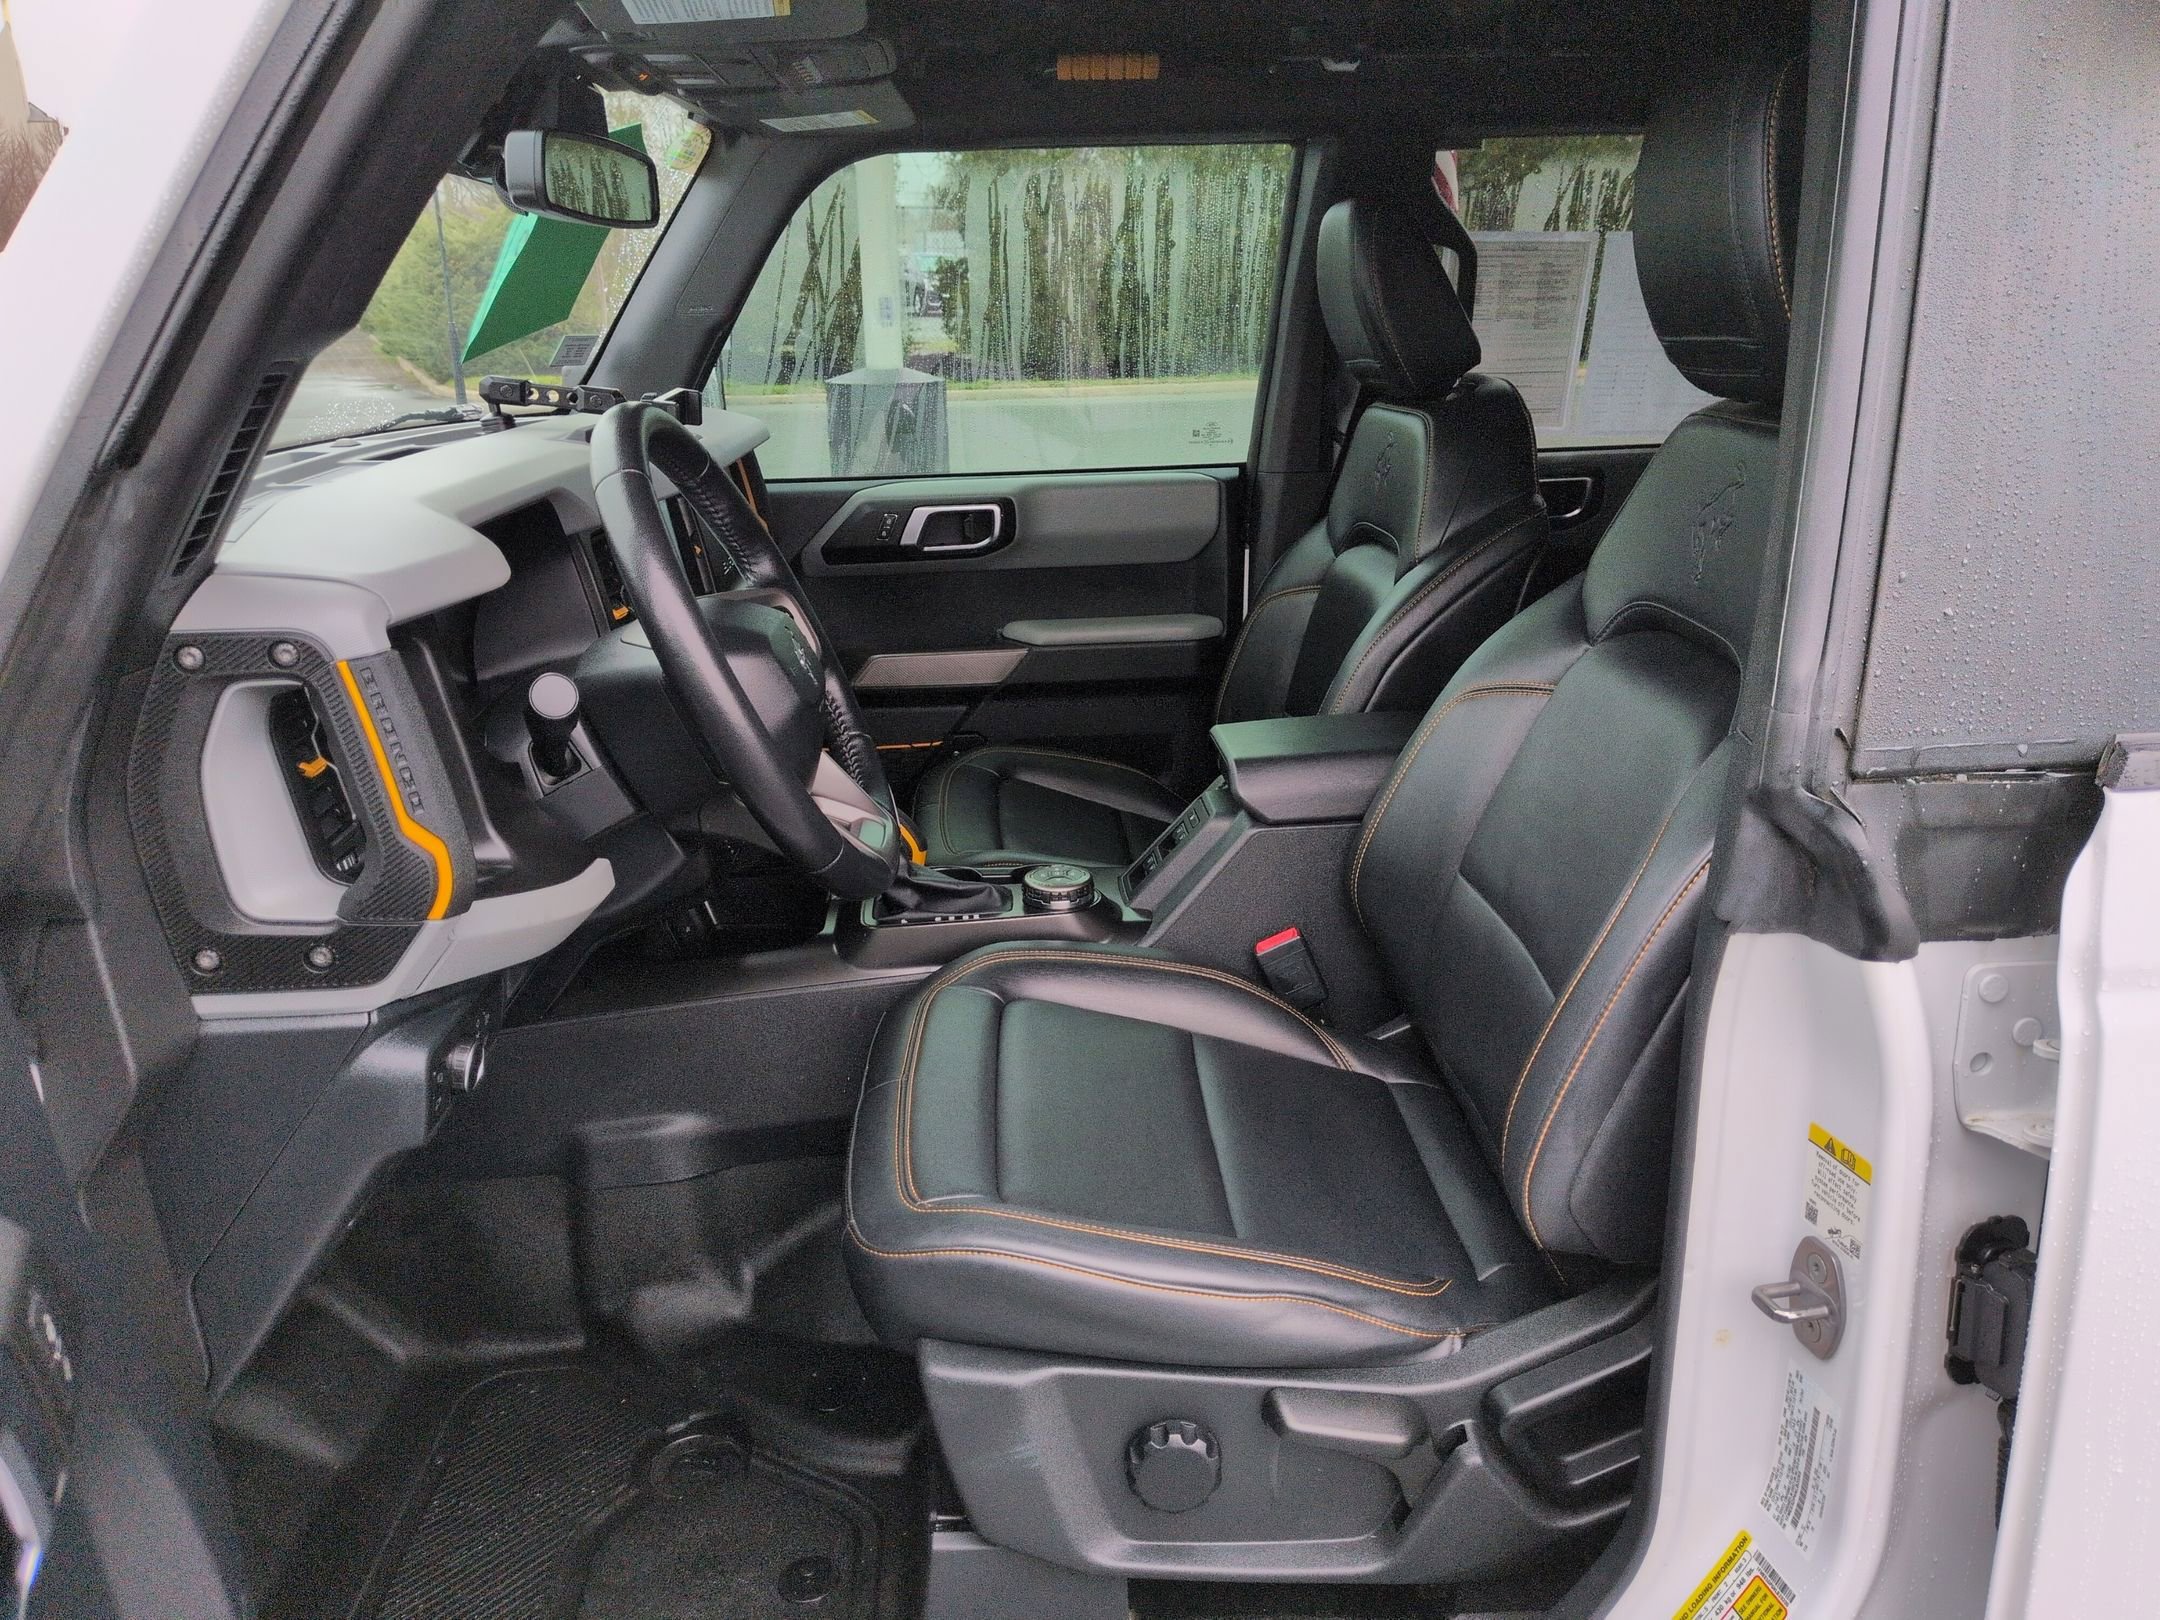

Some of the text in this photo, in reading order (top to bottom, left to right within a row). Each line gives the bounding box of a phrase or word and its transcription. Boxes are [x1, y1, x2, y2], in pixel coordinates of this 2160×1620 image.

[360, 666, 425, 814] BRONCO
[1688, 1583, 1714, 1613] LOADING
[1712, 1535, 1748, 1584] INFORMATION
